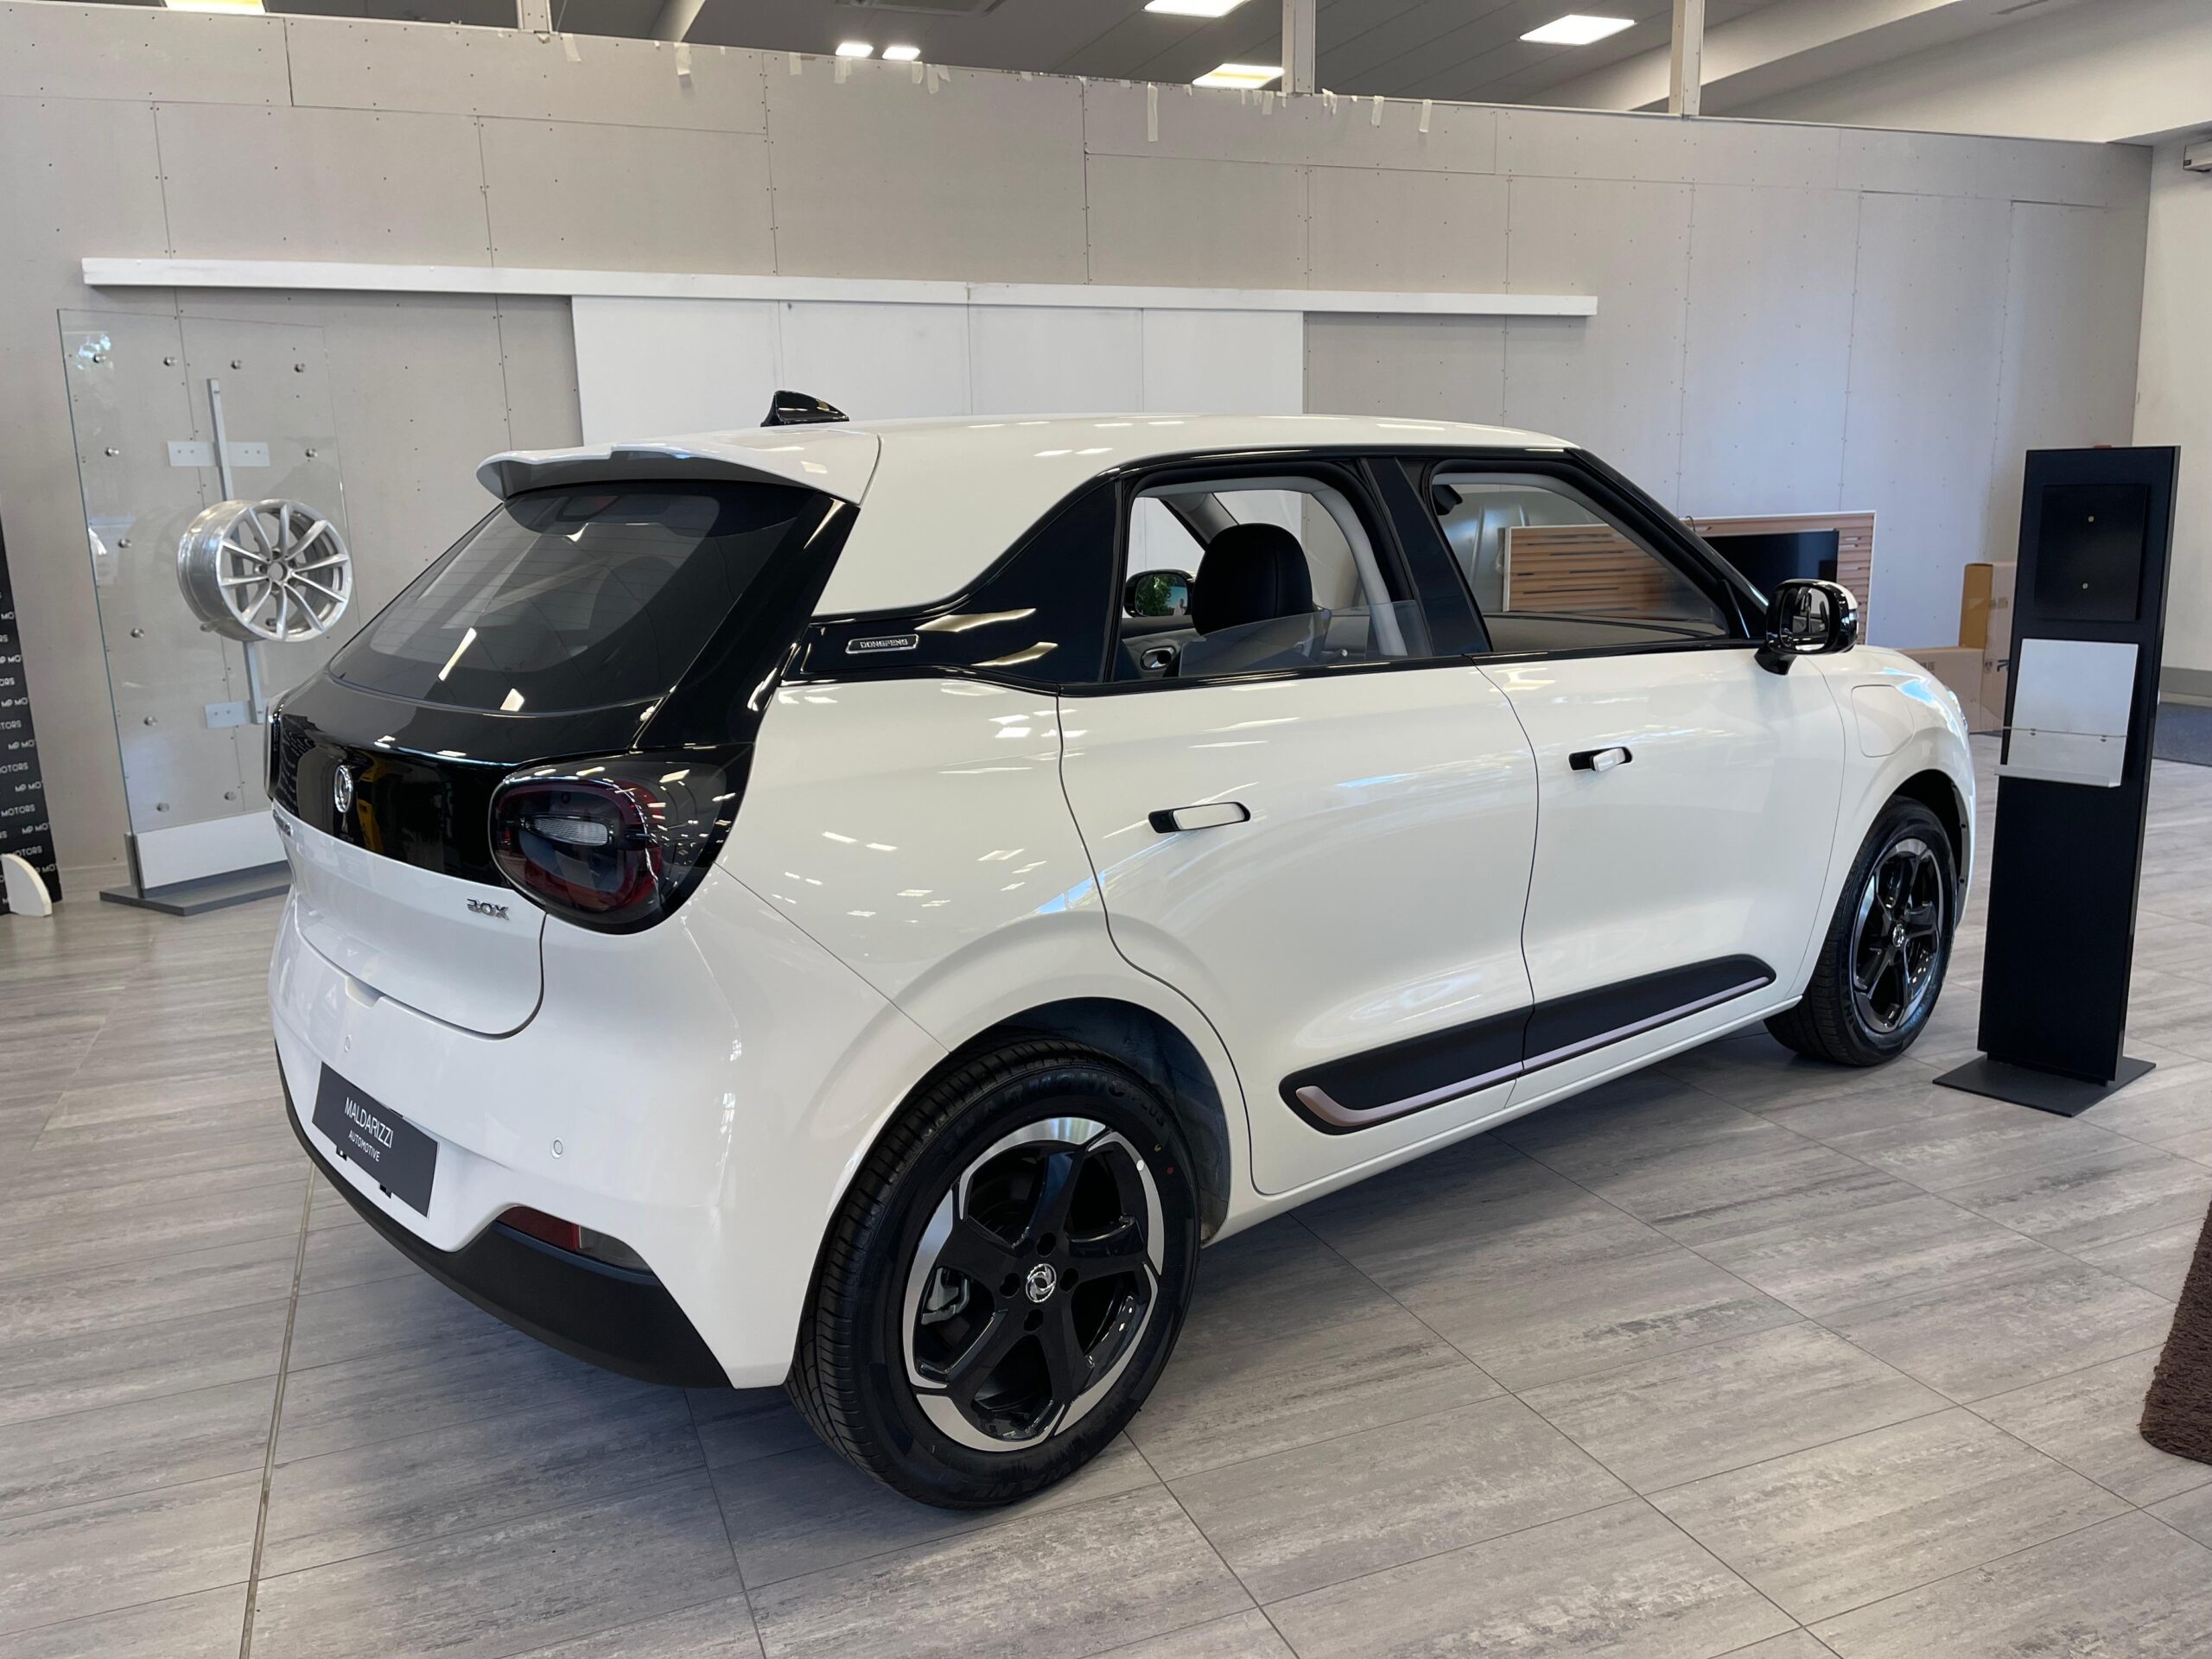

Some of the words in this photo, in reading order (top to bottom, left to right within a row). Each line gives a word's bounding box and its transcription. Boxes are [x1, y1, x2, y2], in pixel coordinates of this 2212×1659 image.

[860, 639, 908, 649] DONGFENG
[0, 762, 29, 774] OTORS
[15, 784, 27, 792] MP
[1, 804, 35, 817] MOTORS
[22, 825, 34, 835] MP
[14, 845, 42, 858] OTORS
[466, 898, 510, 921] BOX
[344, 1096, 394, 1148] MALDARIZZI
[348, 1129, 381, 1162] AUTOMOTIVE
